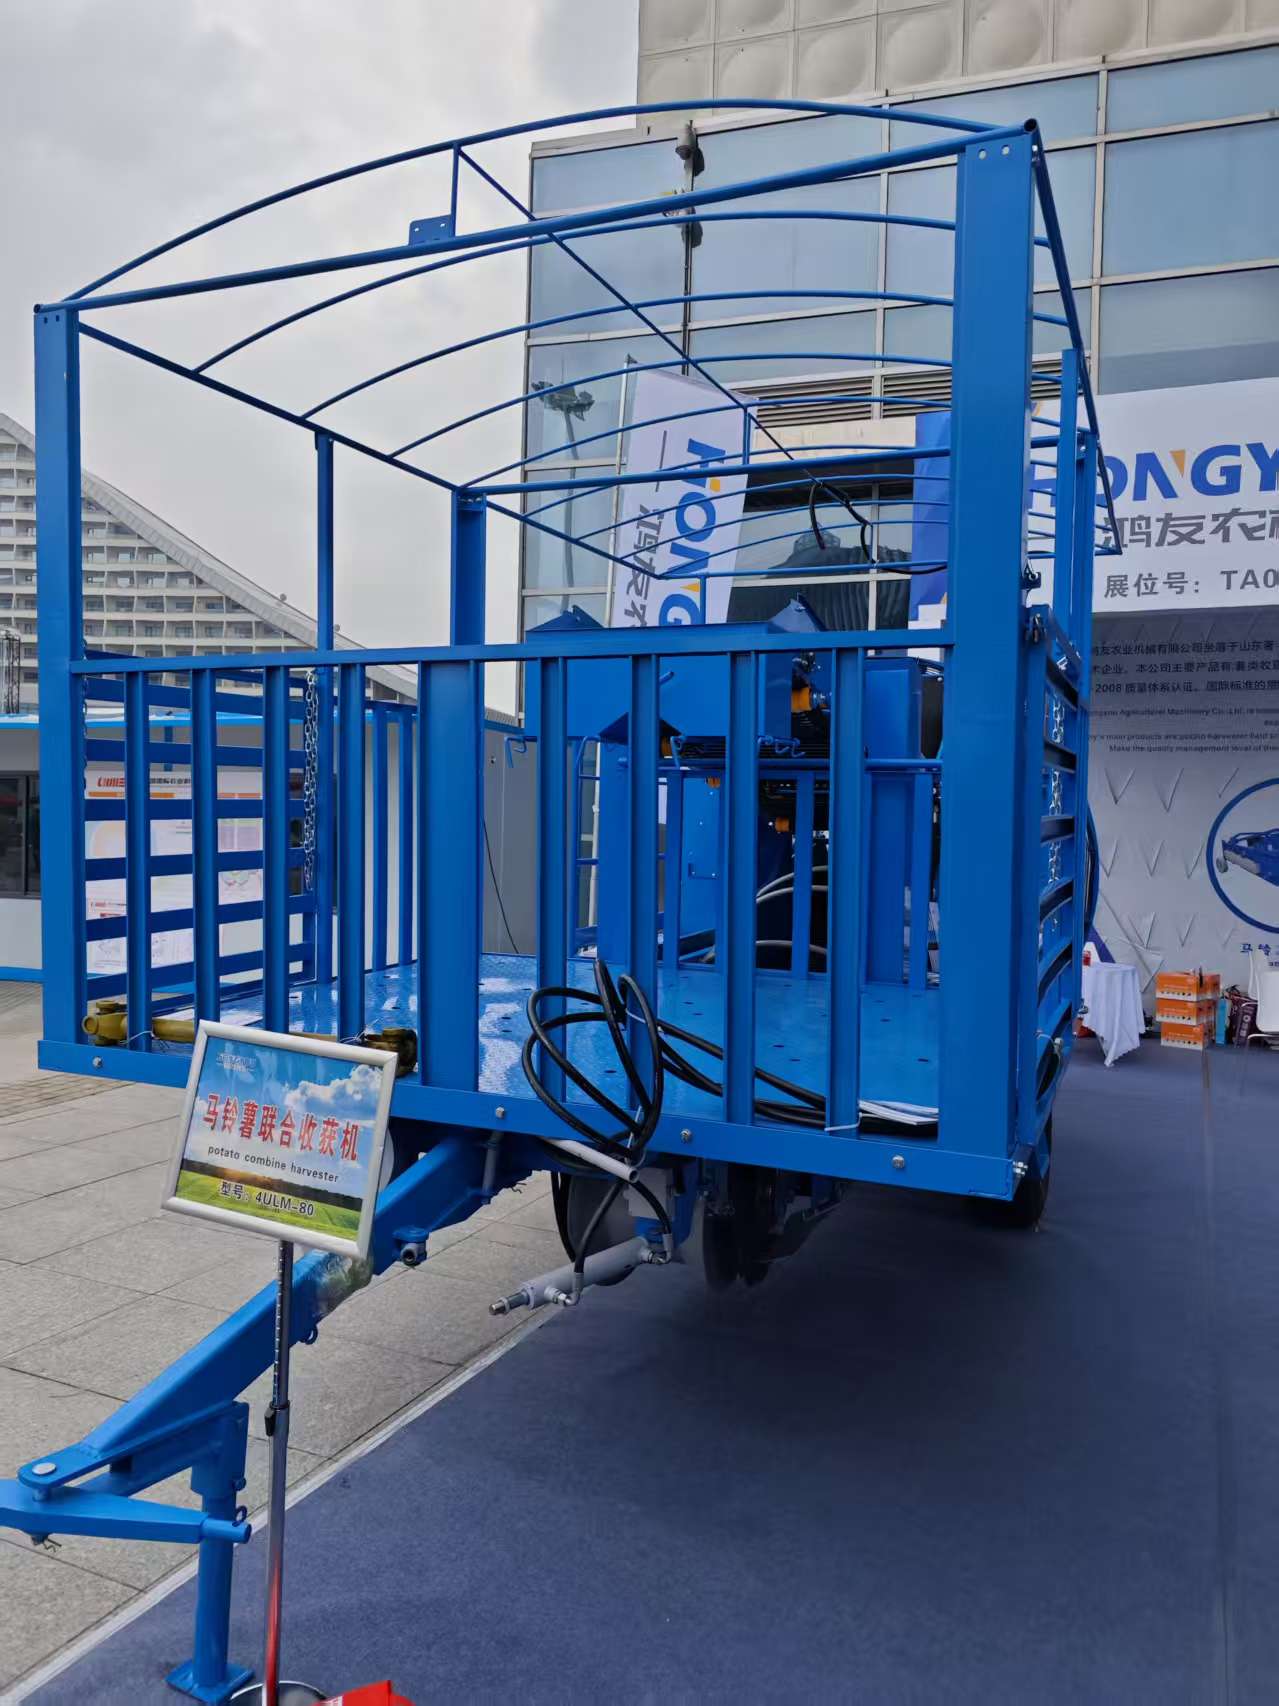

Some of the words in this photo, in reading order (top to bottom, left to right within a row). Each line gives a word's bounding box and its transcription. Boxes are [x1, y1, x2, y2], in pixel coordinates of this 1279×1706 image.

[1103, 508, 1279, 548] 鸿友农
[203, 1094, 360, 1161] 马铃薯联合收获机
[208, 1145, 240, 1159] potato
[244, 1153, 287, 1170] combine
[290, 1162, 339, 1183] harvester
[255, 1191, 314, 1216] 4ULM-80
